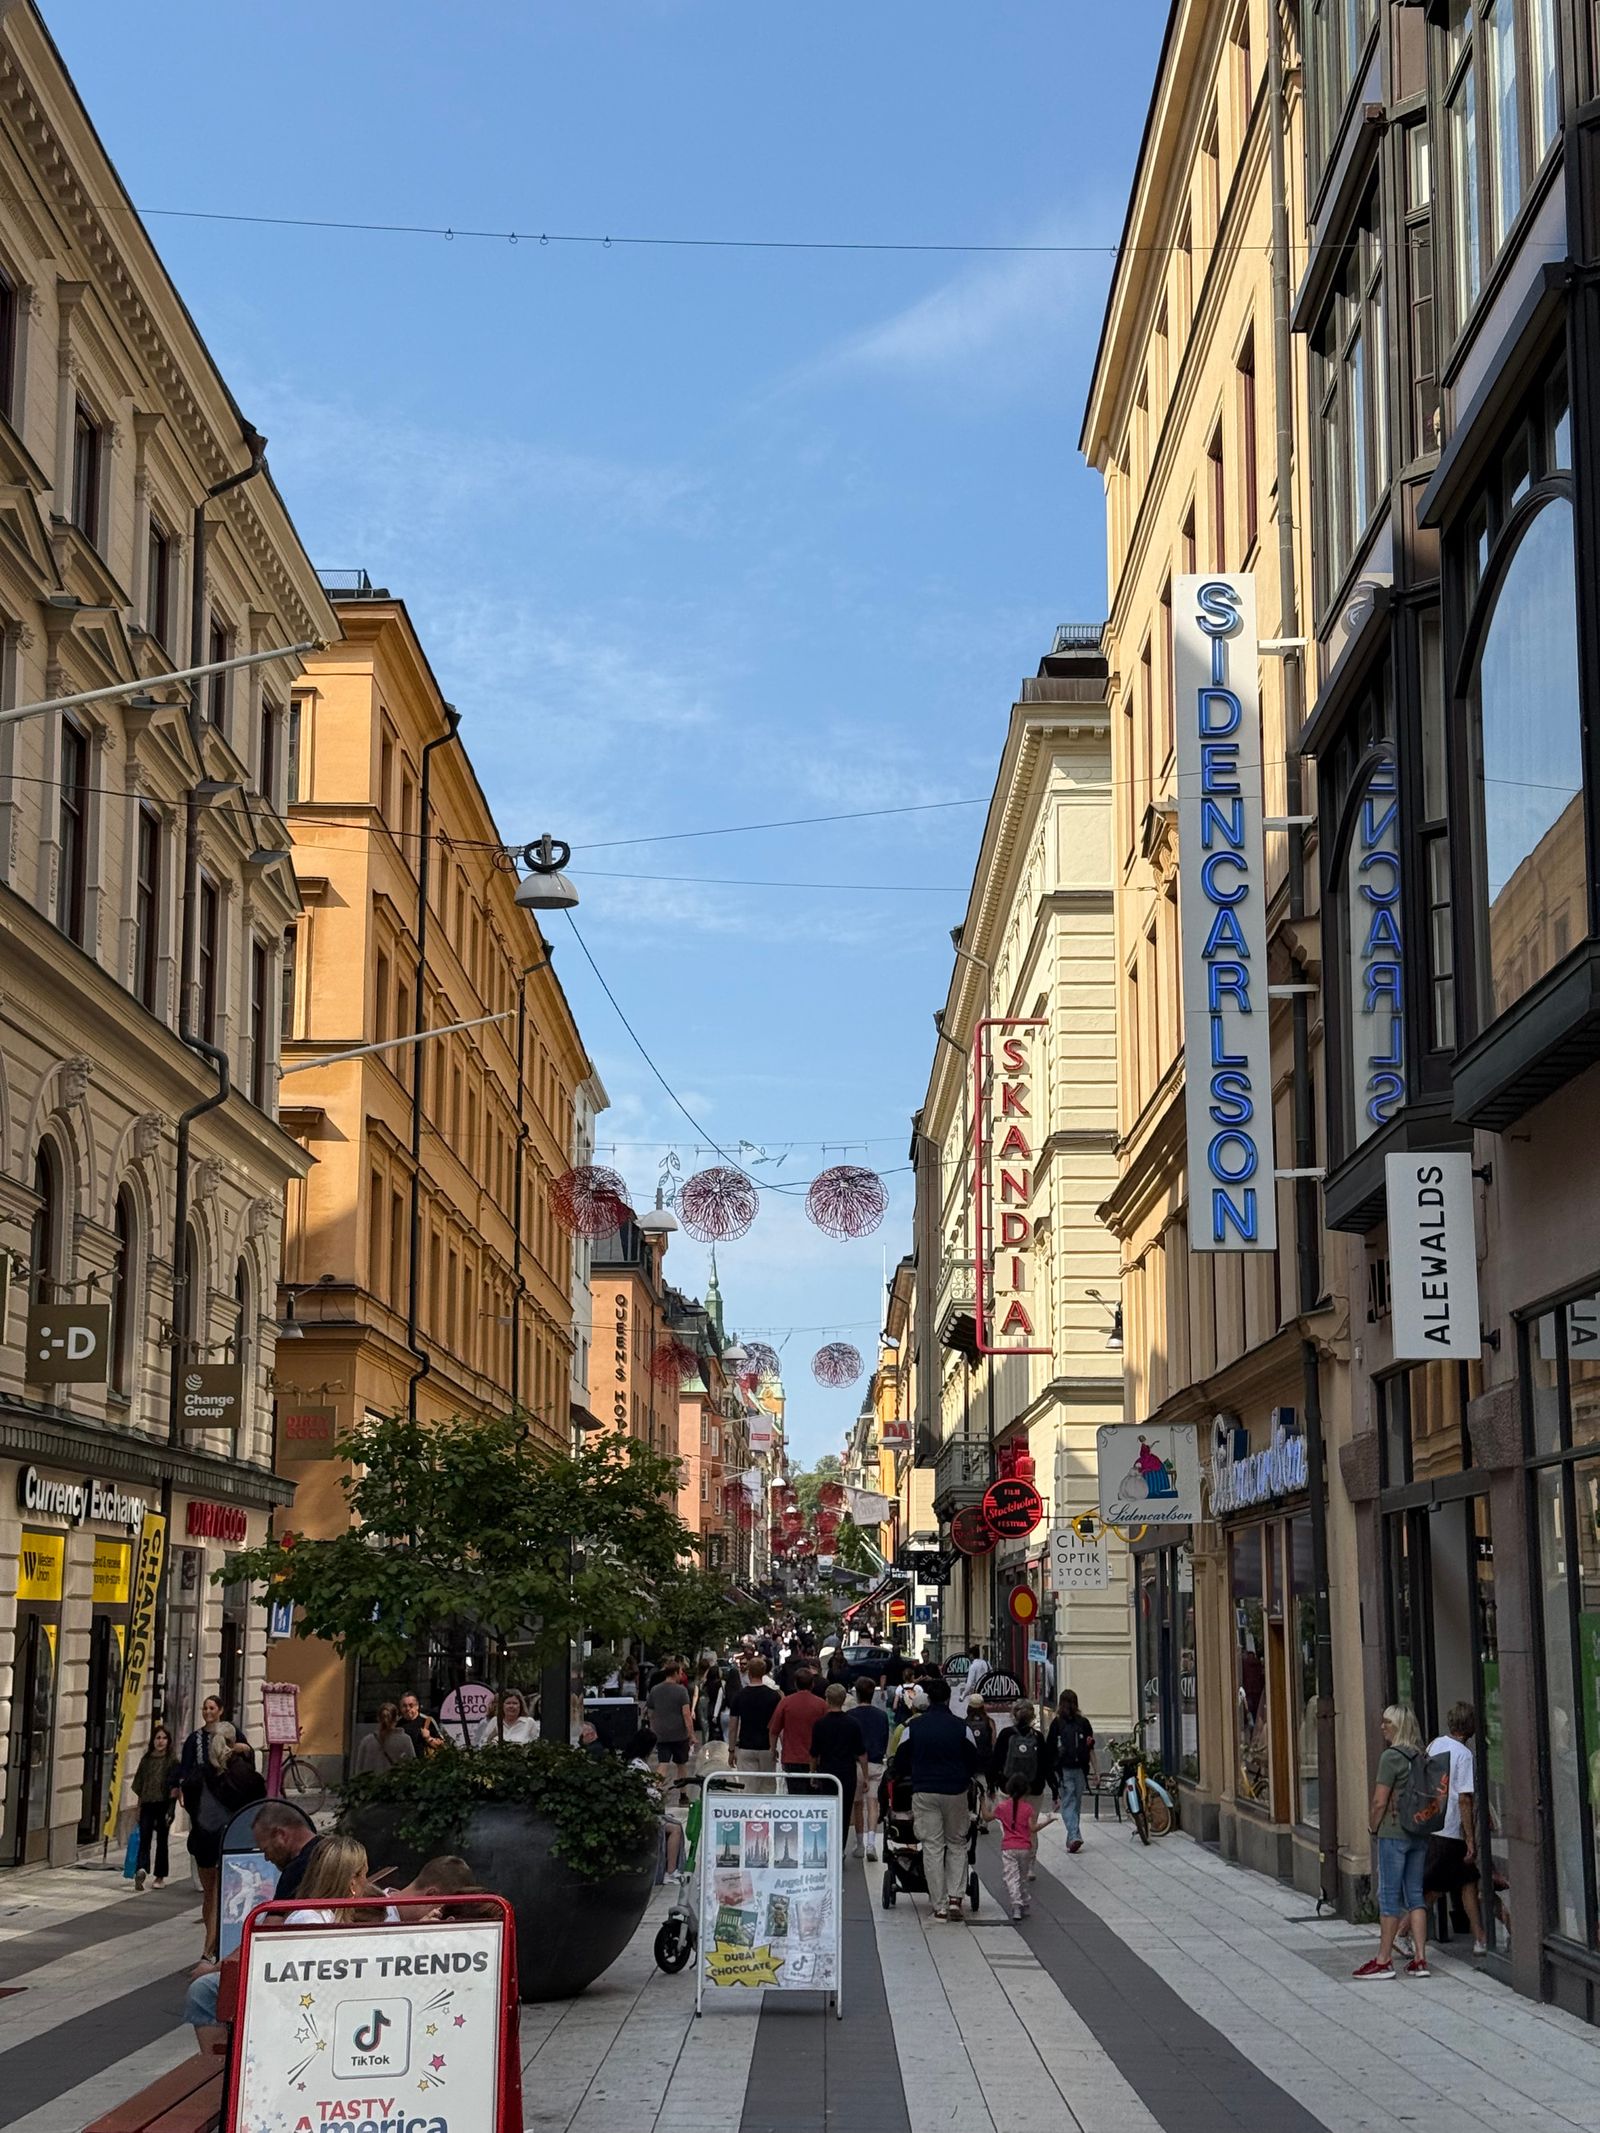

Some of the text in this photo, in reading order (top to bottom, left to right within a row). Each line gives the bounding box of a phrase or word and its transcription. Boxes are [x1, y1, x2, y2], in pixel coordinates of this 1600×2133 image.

[1195, 581, 1259, 1244] SIDENCARLSON
[1000, 1038, 1031, 1335] SKANDIA
[1416, 1165, 1451, 1346] ALEWALDS
[39, 1326, 97, 1361] :-D
[614, 1293, 628, 1382] QUEENS
[184, 1394, 235, 1407] Change
[184, 1406, 224, 1419] Group
[286, 1415, 329, 1427] DIRTY
[286, 1428, 328, 1440] COCO
[24, 1465, 88, 1527] Currency
[1003, 1488, 1021, 1496] FILM
[987, 1497, 1038, 1520] Stockholm
[1106, 1503, 1193, 1523] Sidencarlson
[37, 1552, 55, 1568] Western
[1057, 1552, 1100, 1564] OPTIK
[37, 1567, 50, 1582] Union
[1059, 1568, 1101, 1577] STOCK
[129, 1528, 161, 1696] CHANGE
[980, 1675, 1021, 1696] SKANDIA
[714, 1809, 829, 1819] DUBAI CHOCOLATE
[774, 1872, 827, 1889] Angel Hair
[724, 1952, 755, 1962] DUBAI
[264, 1951, 489, 1983] LATEST TRENDS
[711, 1961, 772, 1977] CHOCOLATE
[316, 2097, 396, 2121] TASTY
